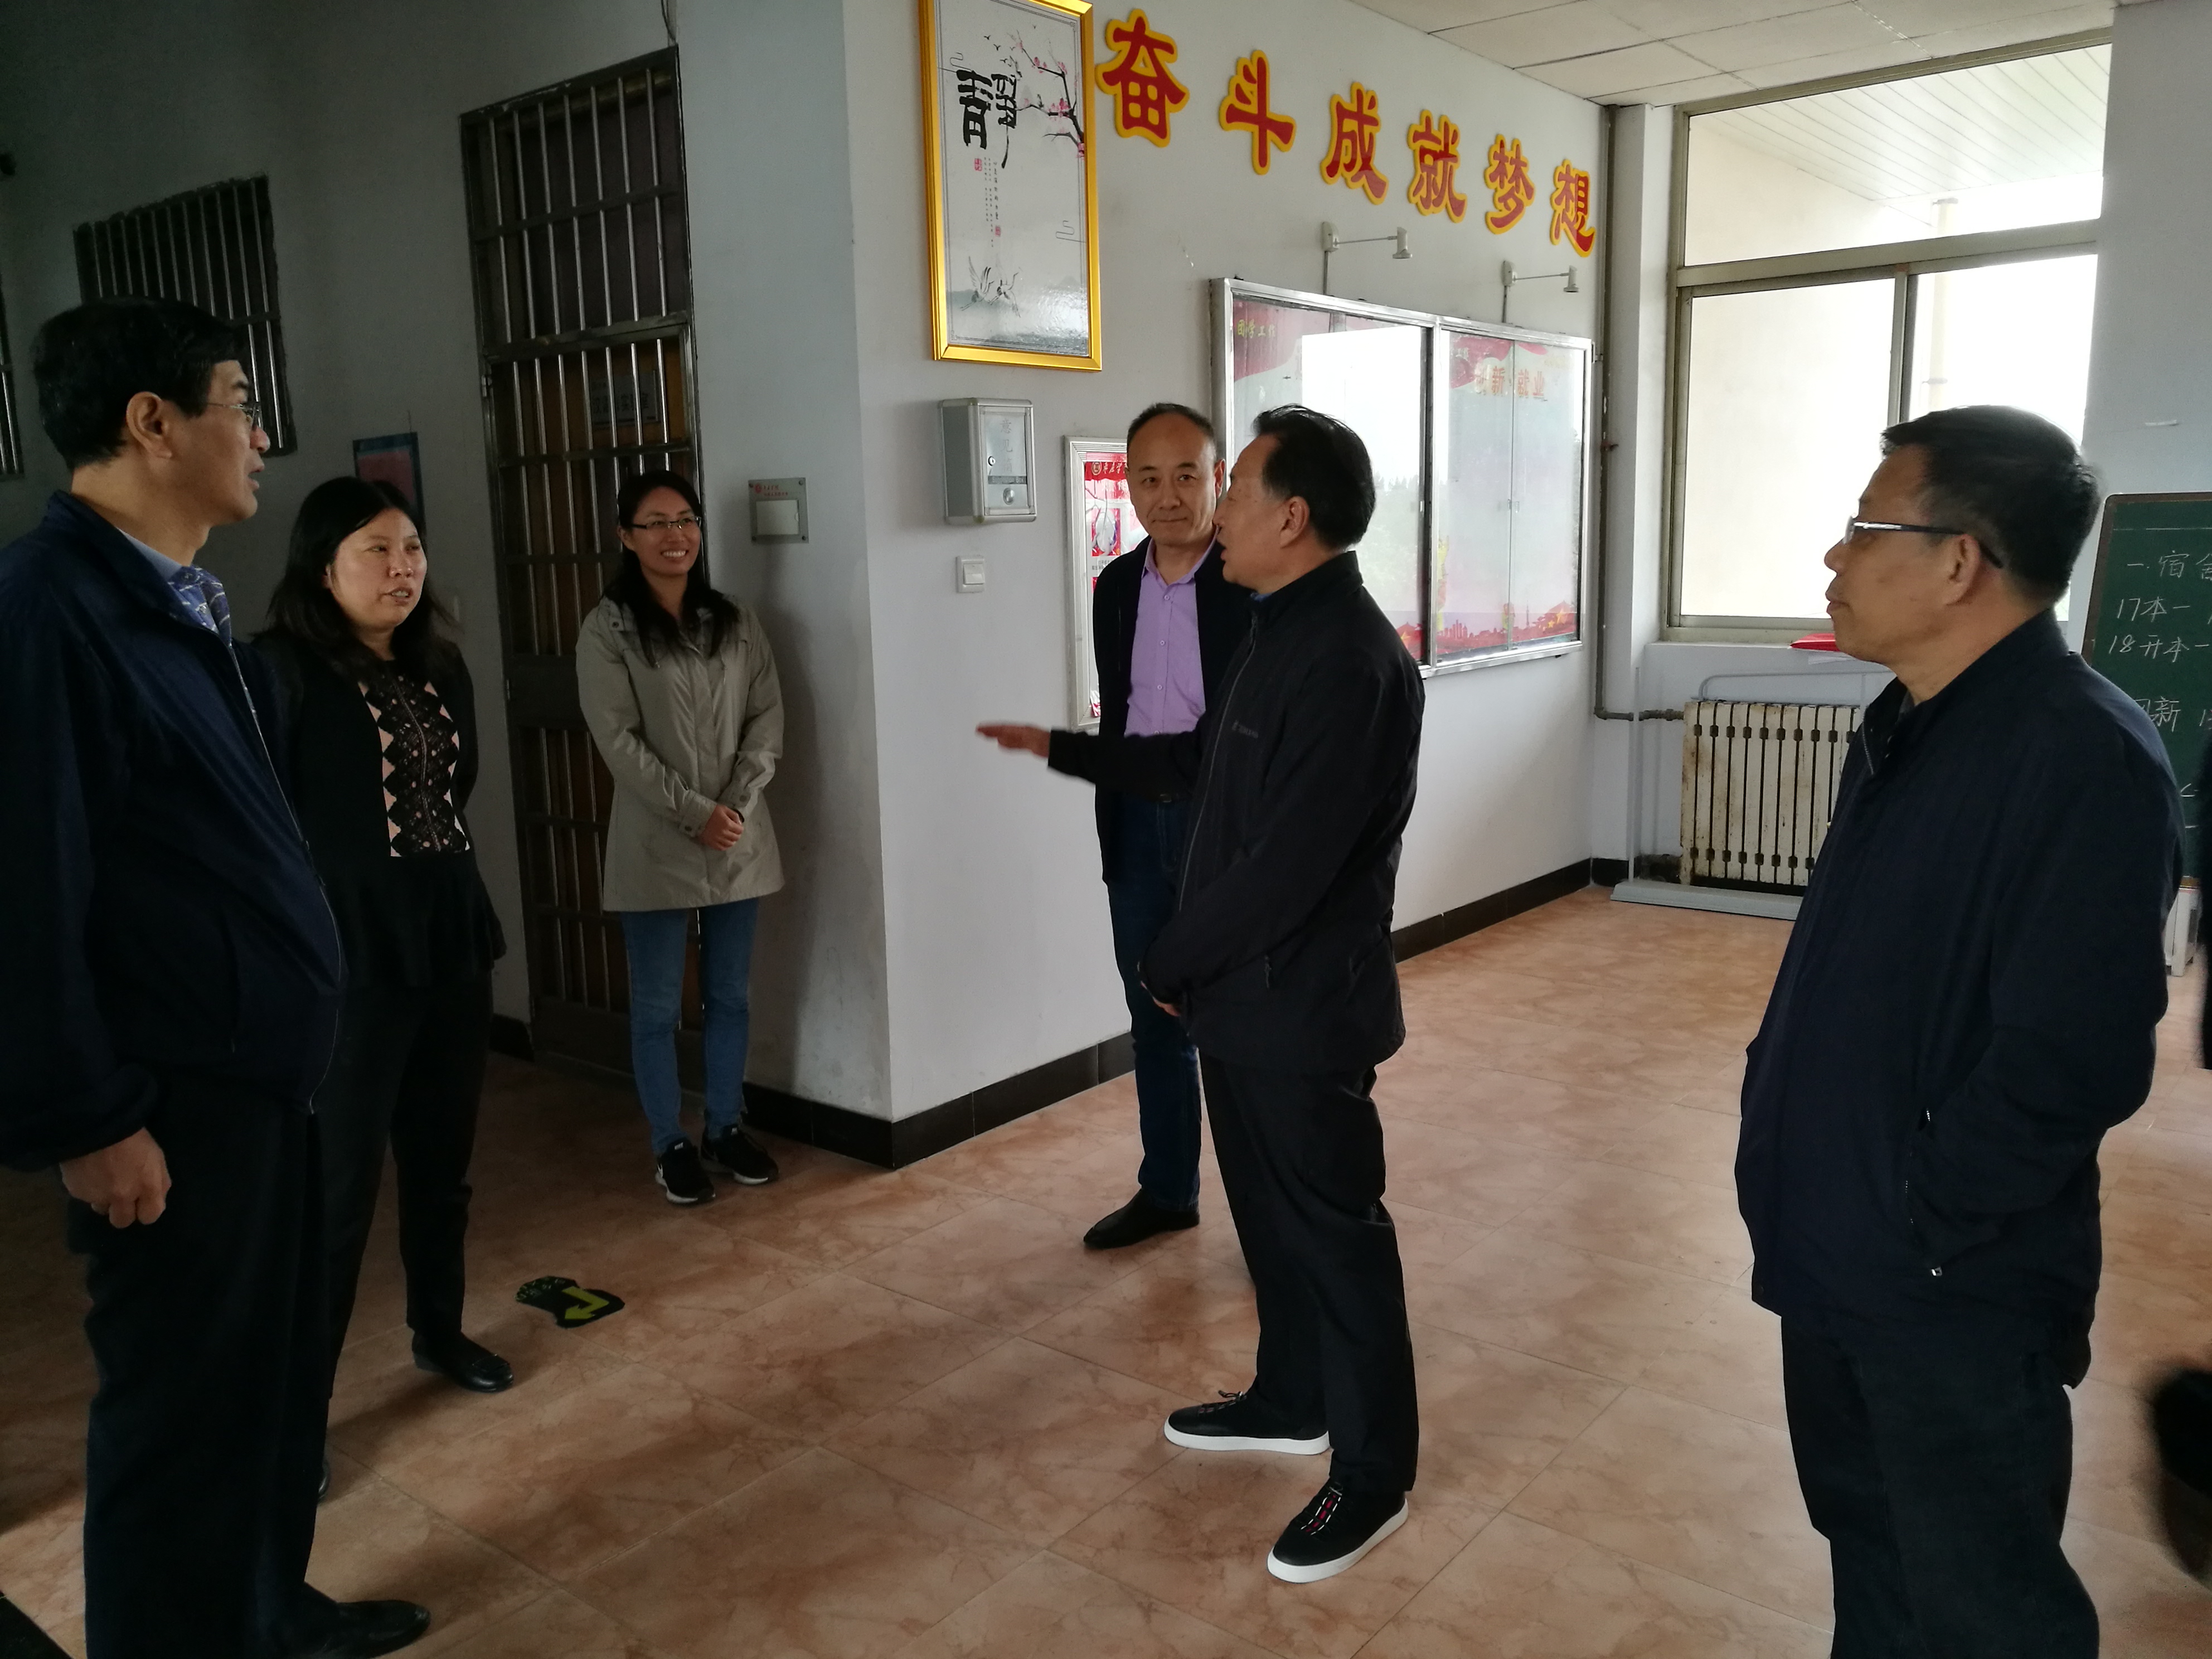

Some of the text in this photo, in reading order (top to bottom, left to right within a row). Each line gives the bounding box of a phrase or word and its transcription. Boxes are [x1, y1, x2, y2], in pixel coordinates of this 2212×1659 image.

[1096, 9, 1595, 257] 奋斗成就梦想
